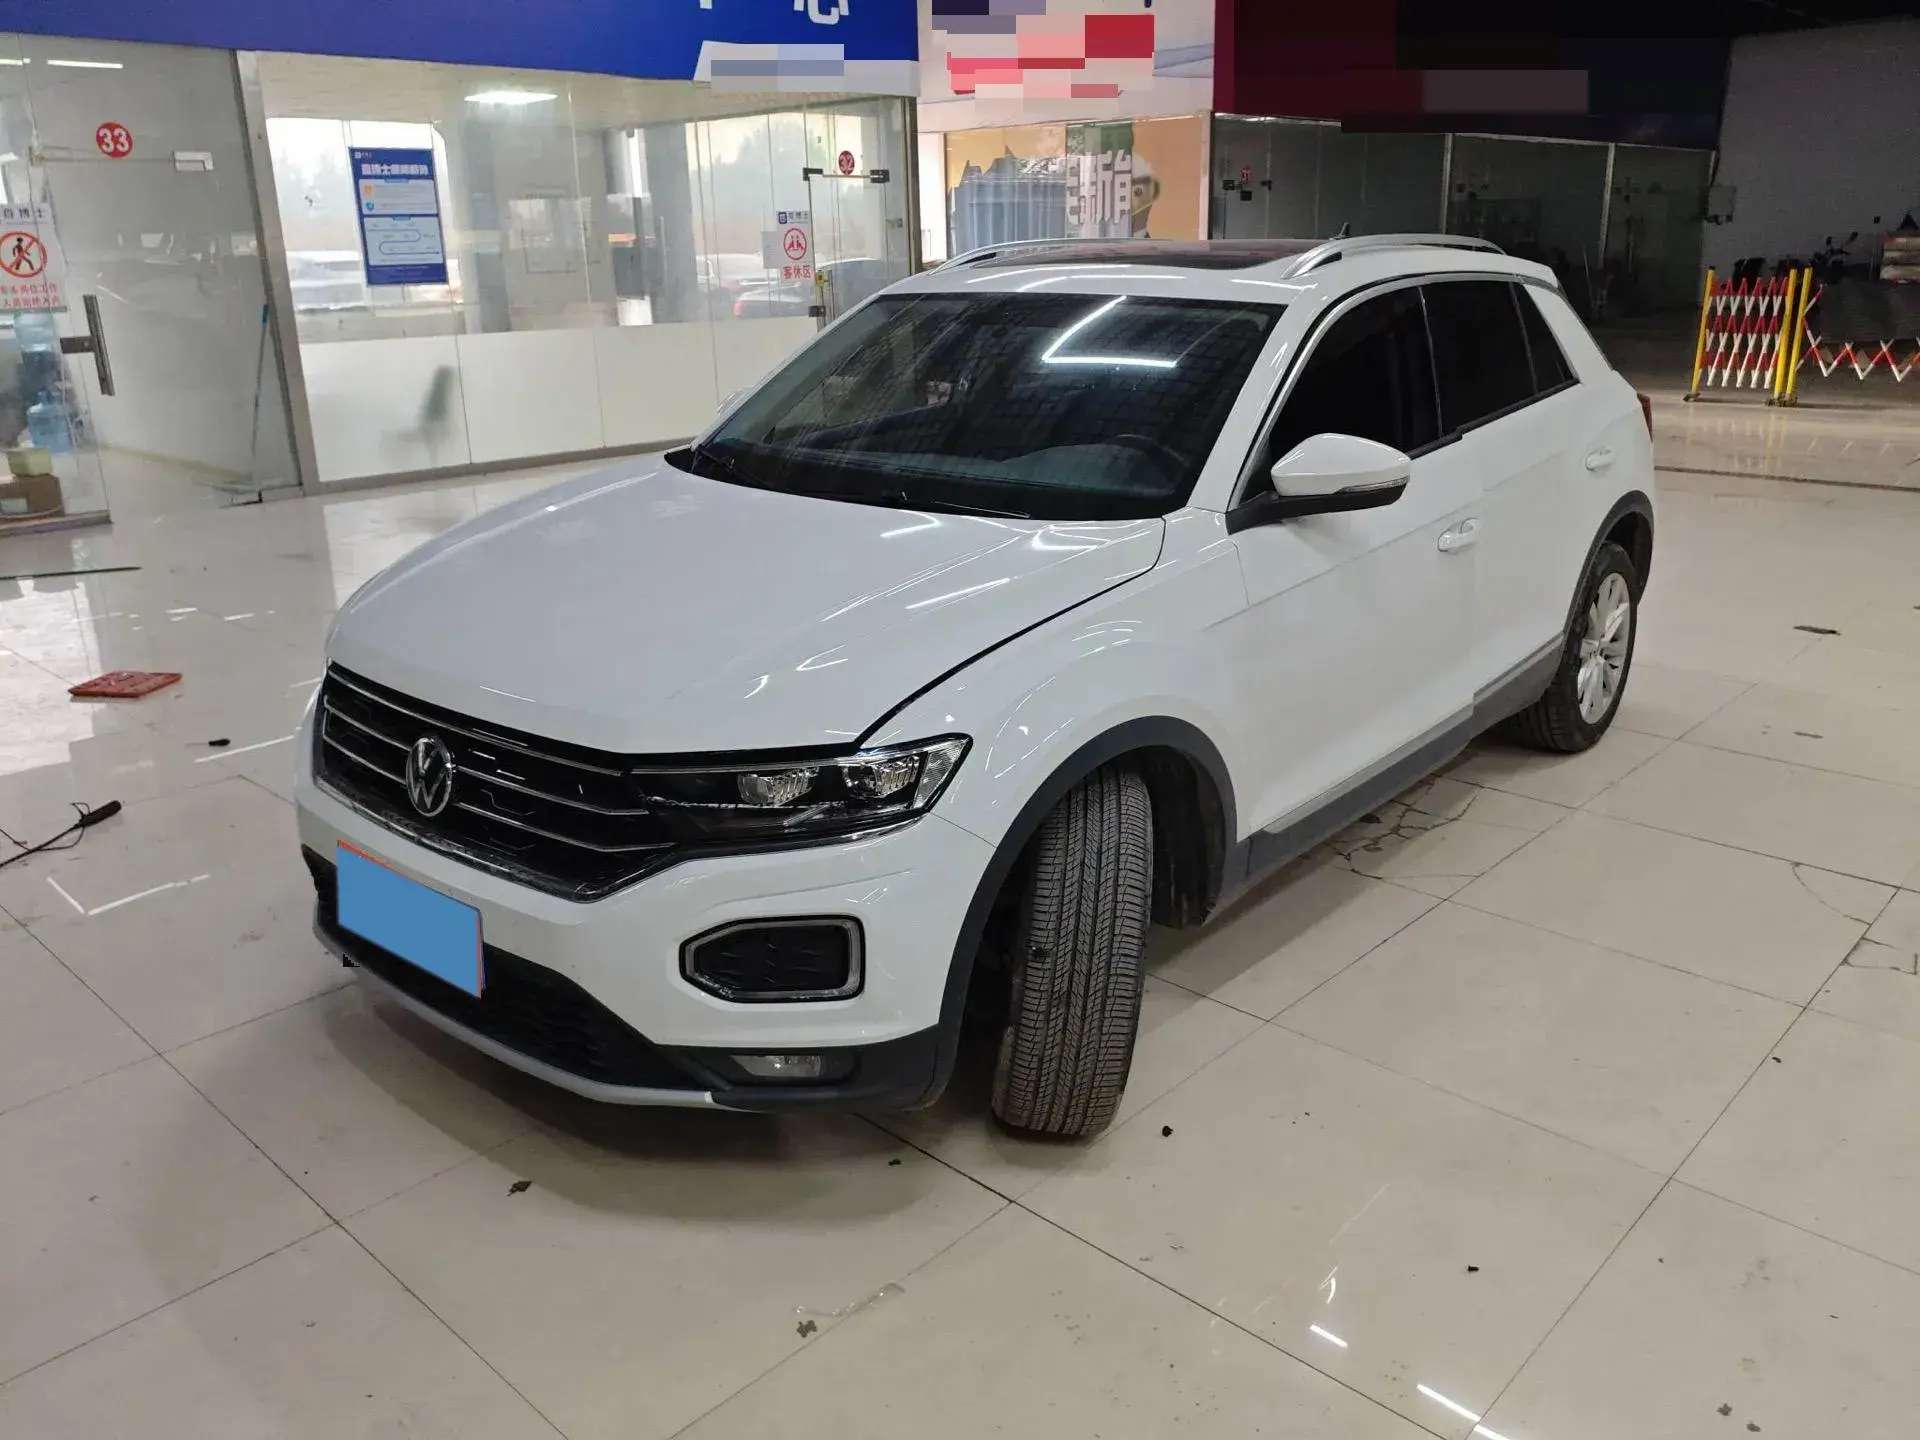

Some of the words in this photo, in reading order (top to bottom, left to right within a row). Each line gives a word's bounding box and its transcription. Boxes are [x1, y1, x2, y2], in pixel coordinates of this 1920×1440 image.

[98, 128, 129, 153] 33
[783, 265, 811, 279] 客休区
